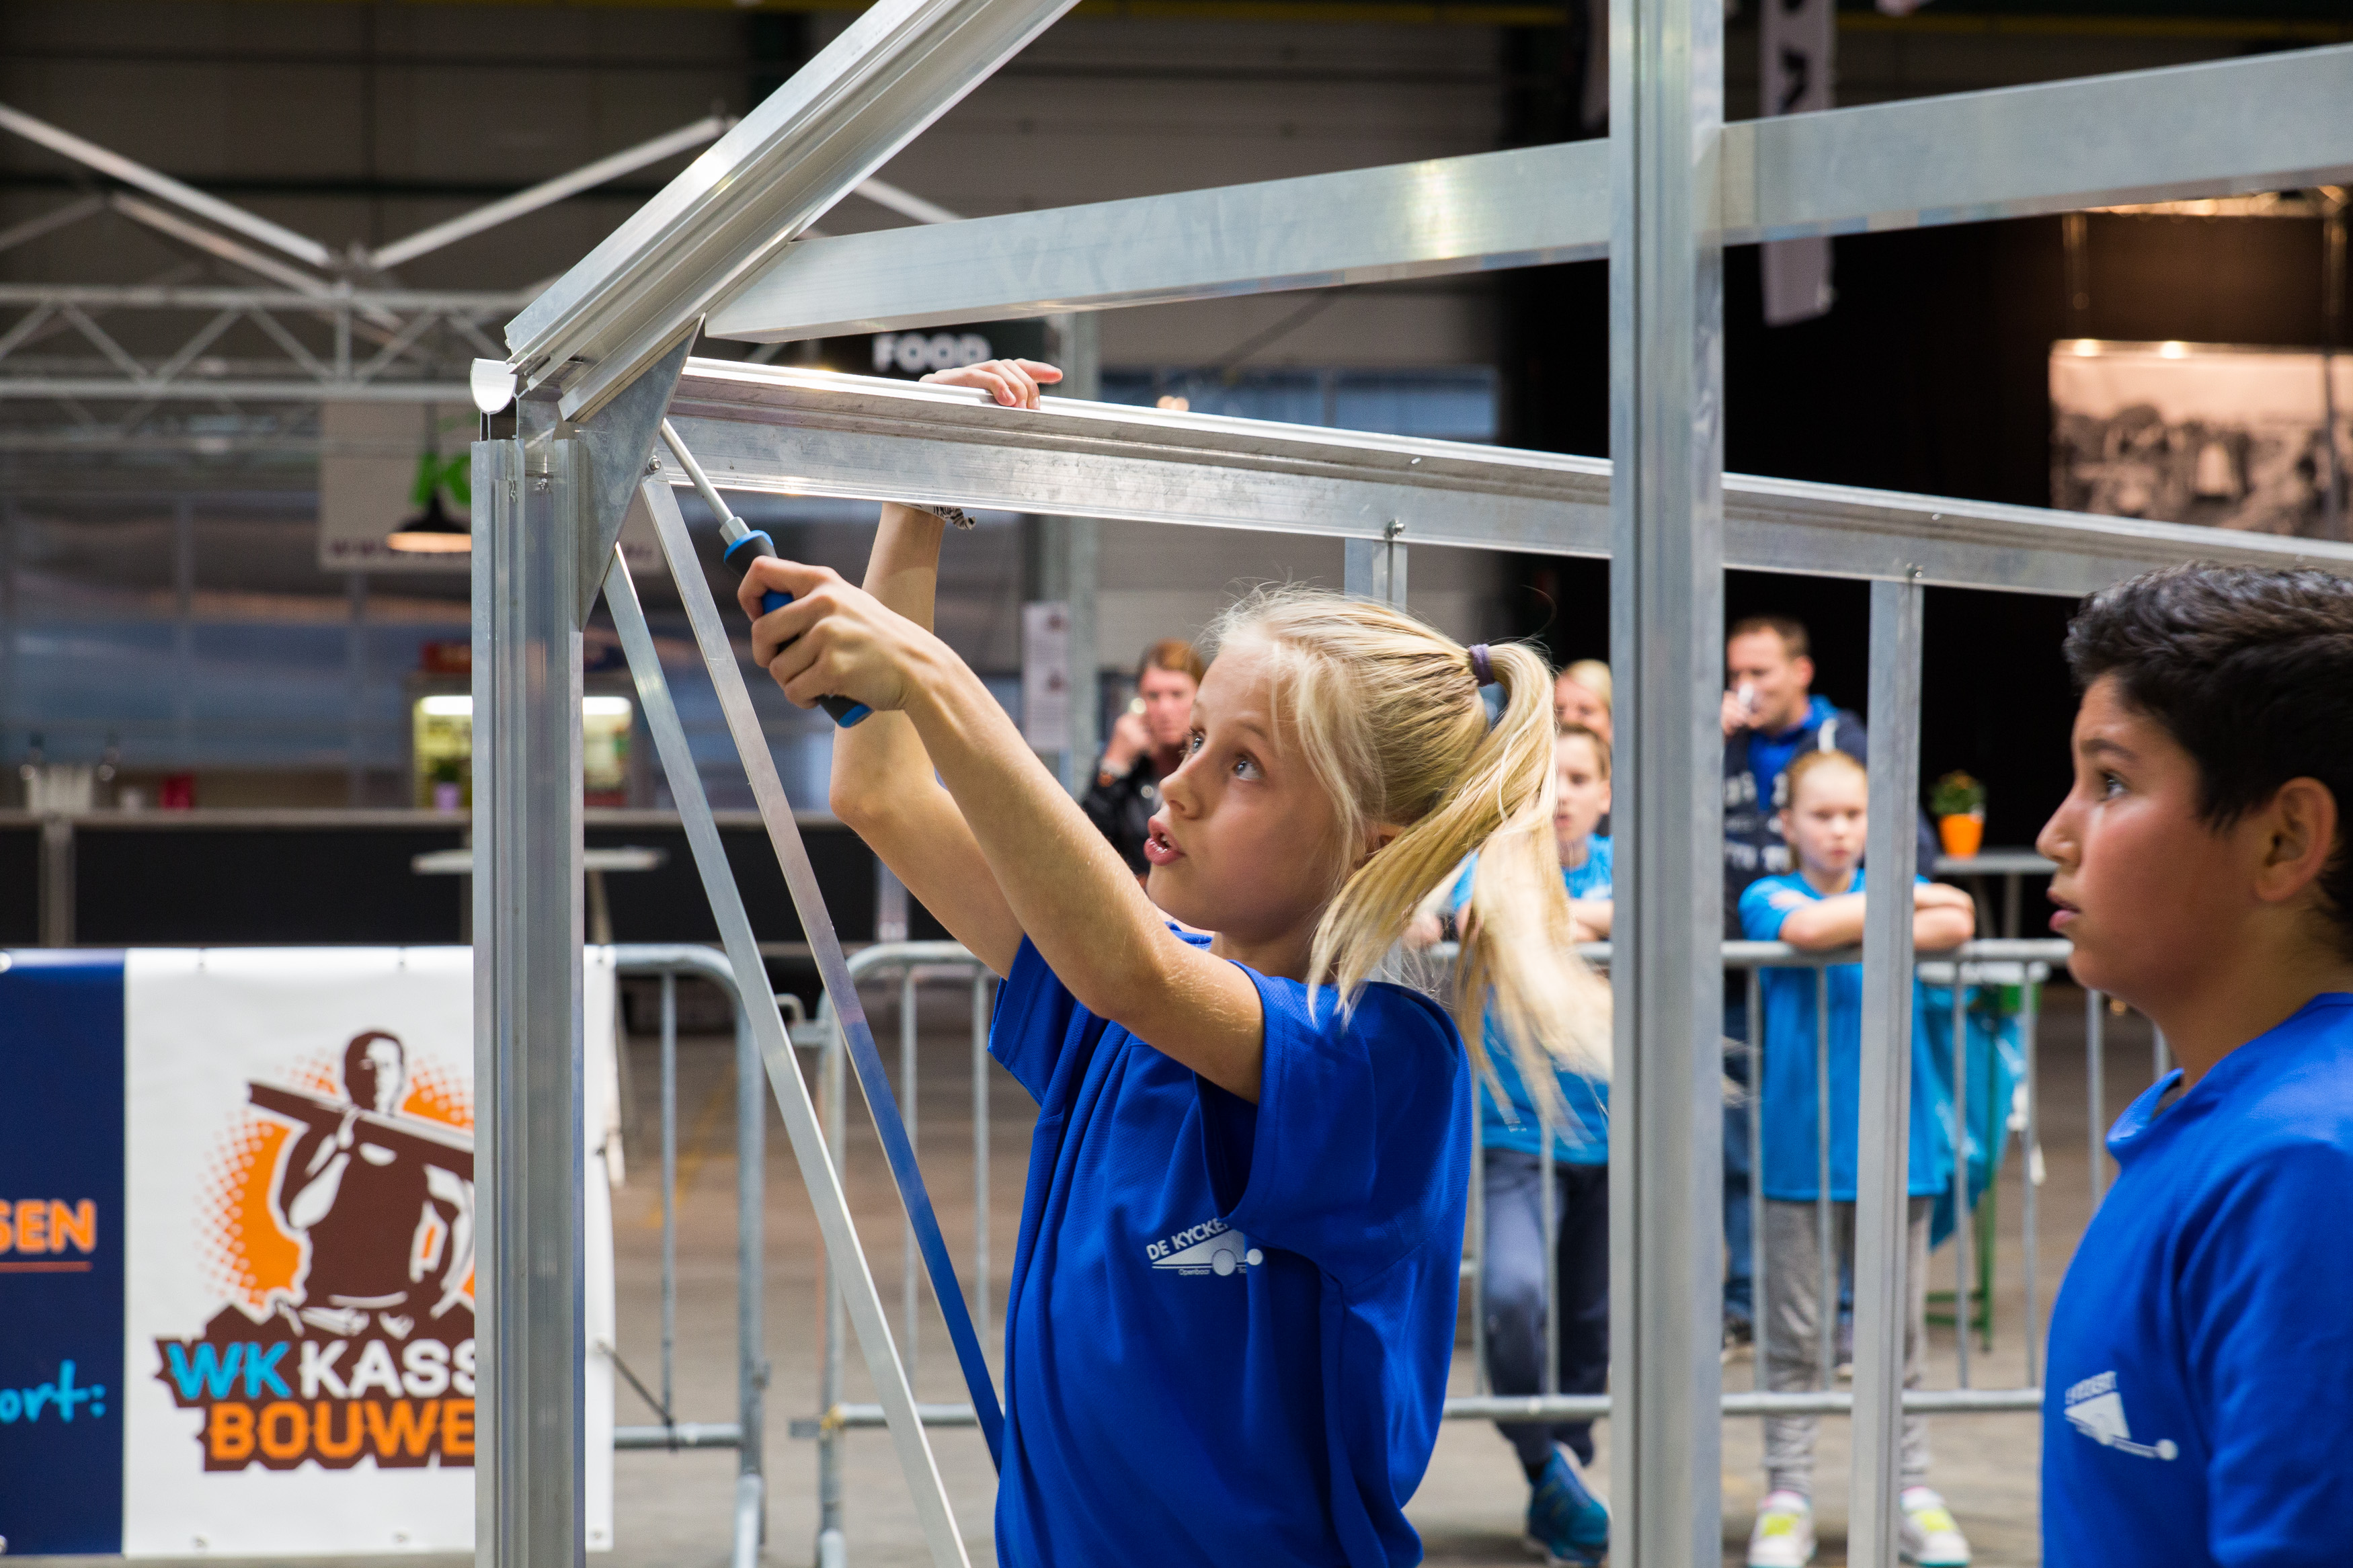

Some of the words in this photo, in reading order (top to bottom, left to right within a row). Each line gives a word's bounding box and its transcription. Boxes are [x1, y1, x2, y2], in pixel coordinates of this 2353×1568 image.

[873, 333, 992, 372] FOOD
[1146, 1239, 1170, 1260] DE
[1171, 1218, 1228, 1249] KYCKE
[166, 1342, 292, 1399] WK
[210, 1400, 475, 1460] BOUWE
